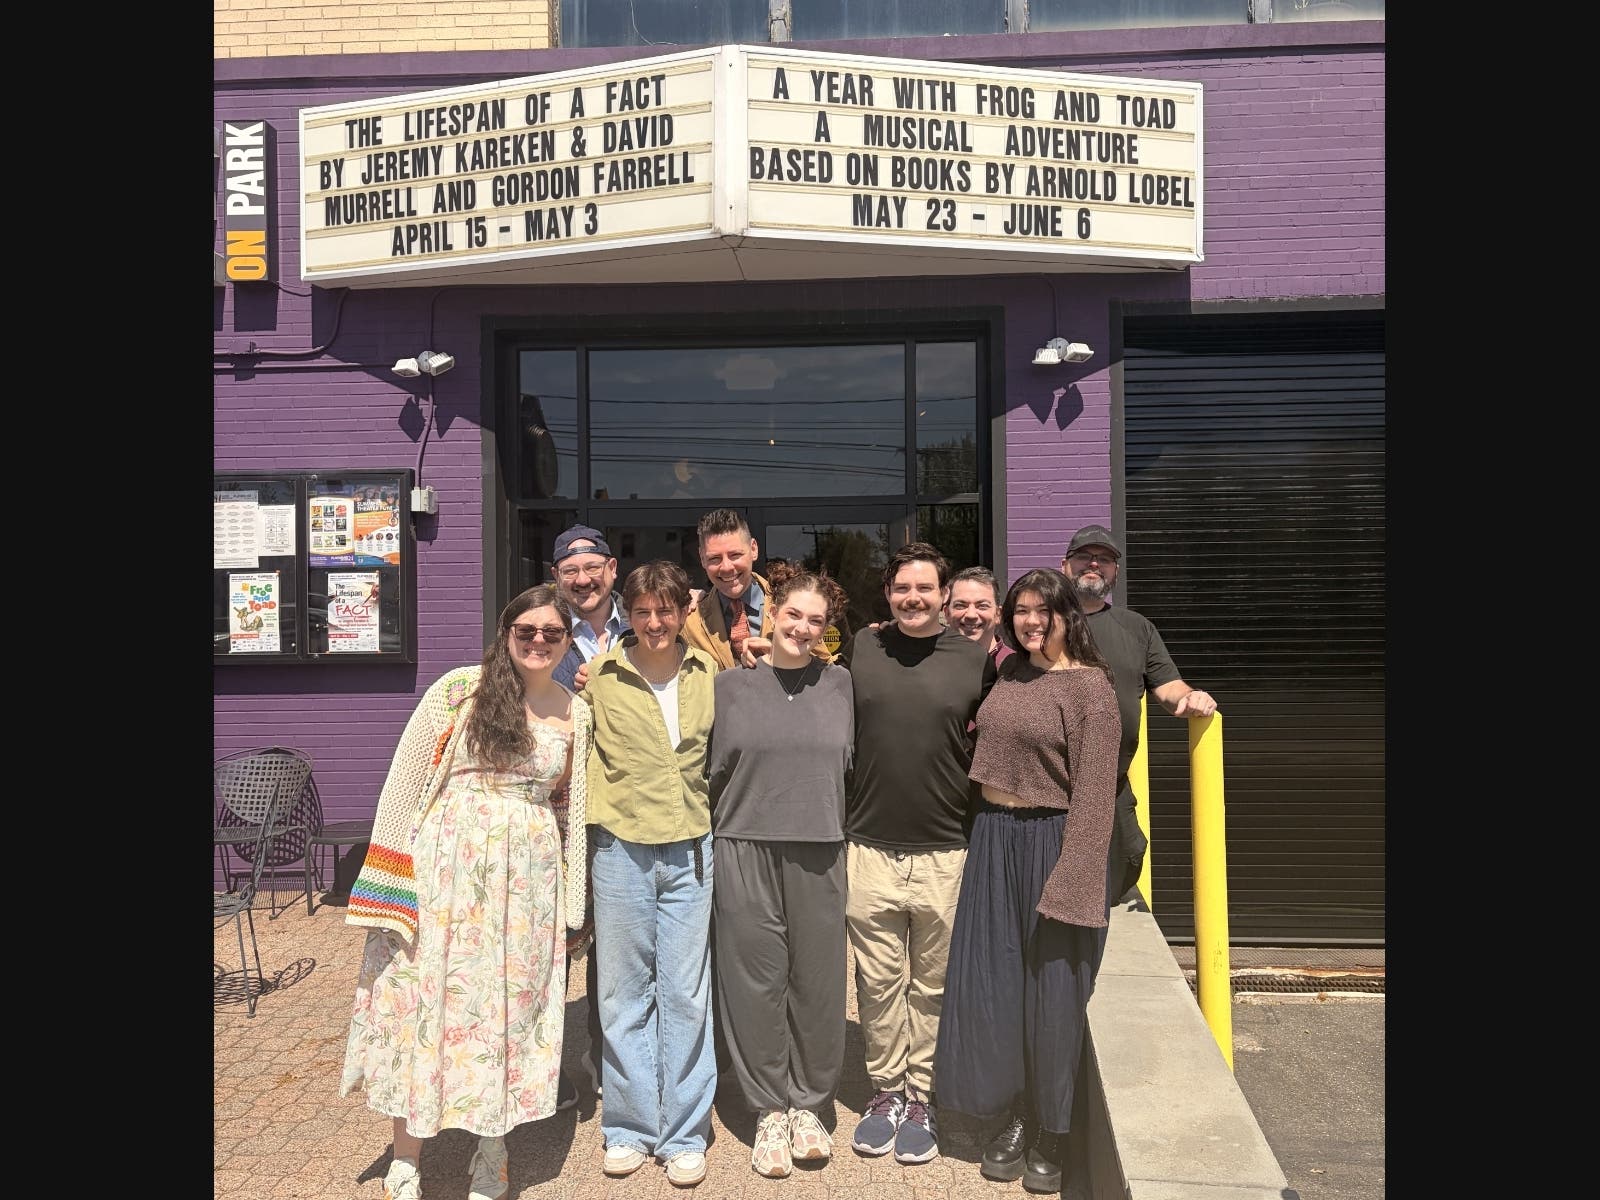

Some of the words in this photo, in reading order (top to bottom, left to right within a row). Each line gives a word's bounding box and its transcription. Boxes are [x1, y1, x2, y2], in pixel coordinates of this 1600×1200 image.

[345, 115, 382, 149] THE
[404, 98, 505, 142] LIFESPAN
[526, 91, 551, 125] OF
[570, 87, 584, 119] A
[606, 74, 666, 114] FACT
[773, 67, 789, 99] A
[810, 70, 873, 106] YEAR
[893, 77, 956, 112] WITH
[976, 84, 1035, 118] FROG
[1054, 90, 1099, 123] AND
[1117, 95, 1175, 129] TOAD
[320, 157, 344, 190] BY
[361, 144, 443, 185] JEREMY
[455, 129, 555, 173] KAREKEN
[571, 126, 587, 158] &
[603, 113, 673, 154] DAVID
[815, 110, 831, 142] A
[864, 114, 972, 152] MUSICAL
[1005, 125, 1138, 164] ADVENTURE
[225, 121, 265, 216] PARK
[325, 186, 417, 227] MURRELL
[433, 179, 476, 214] AND
[492, 165, 579, 207] GORDON
[593, 151, 694, 194] FARRELL
[750, 146, 832, 183] BASED
[847, 152, 878, 186] ON
[892, 155, 970, 192] BOOKS
[985, 162, 1015, 194] BY
[1026, 165, 1116, 202] ARNOLD
[1129, 172, 1194, 208] LOBEL
[392, 220, 453, 256] APRIL
[465, 216, 487, 248] 15
[525, 205, 574, 242] MAY
[584, 202, 598, 235] 3
[853, 194, 907, 228] MAY
[926, 198, 956, 231] 23
[1004, 203, 1062, 237] JUNE
[1077, 207, 1091, 239] 6
[226, 230, 266, 280] ON
[336, 605, 371, 616] FACT
